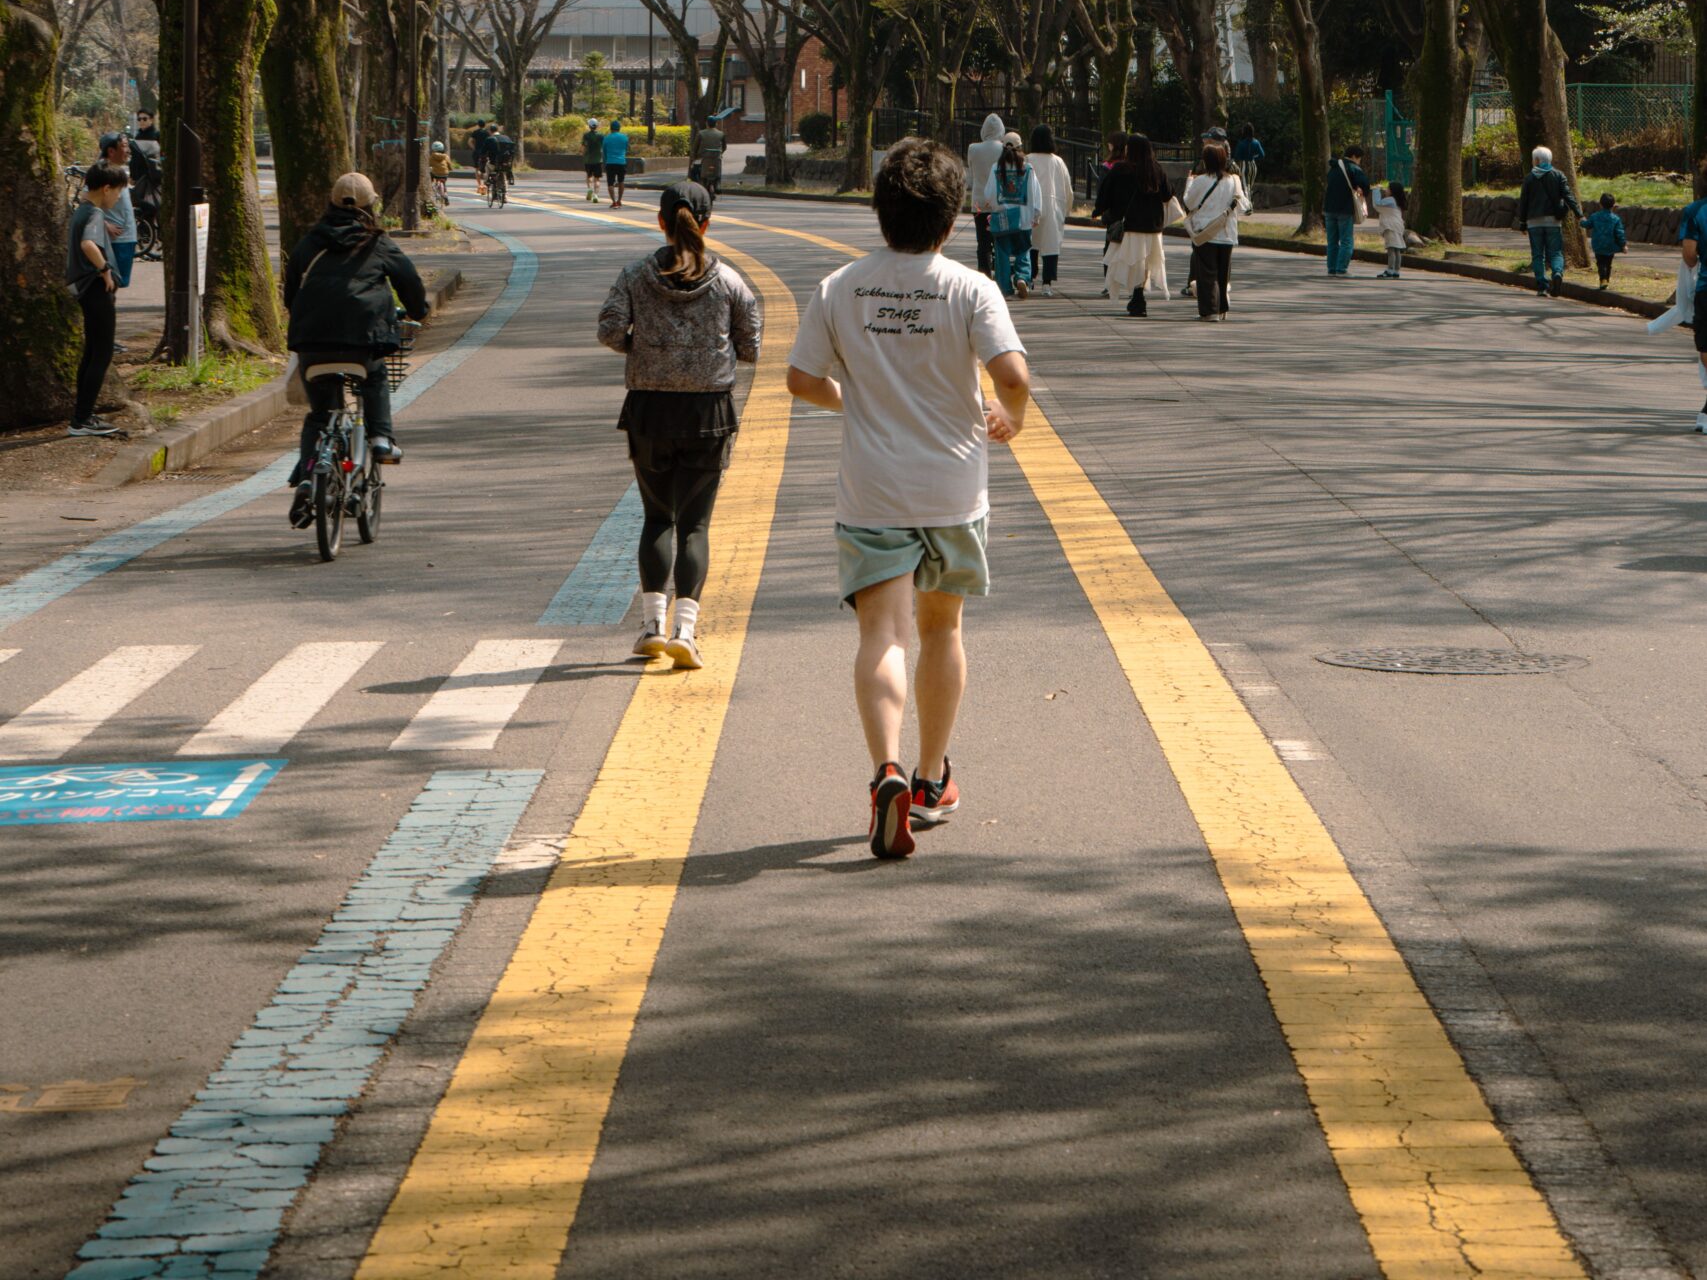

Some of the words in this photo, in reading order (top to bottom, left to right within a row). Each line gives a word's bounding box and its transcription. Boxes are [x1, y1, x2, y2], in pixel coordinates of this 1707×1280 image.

[854, 287, 904, 302] Kickboxing
[913, 289, 947, 301] Fitness
[876, 307, 921, 322] STAGE
[864, 322, 902, 336] Aoyama
[907, 324, 935, 336] Tokyo
